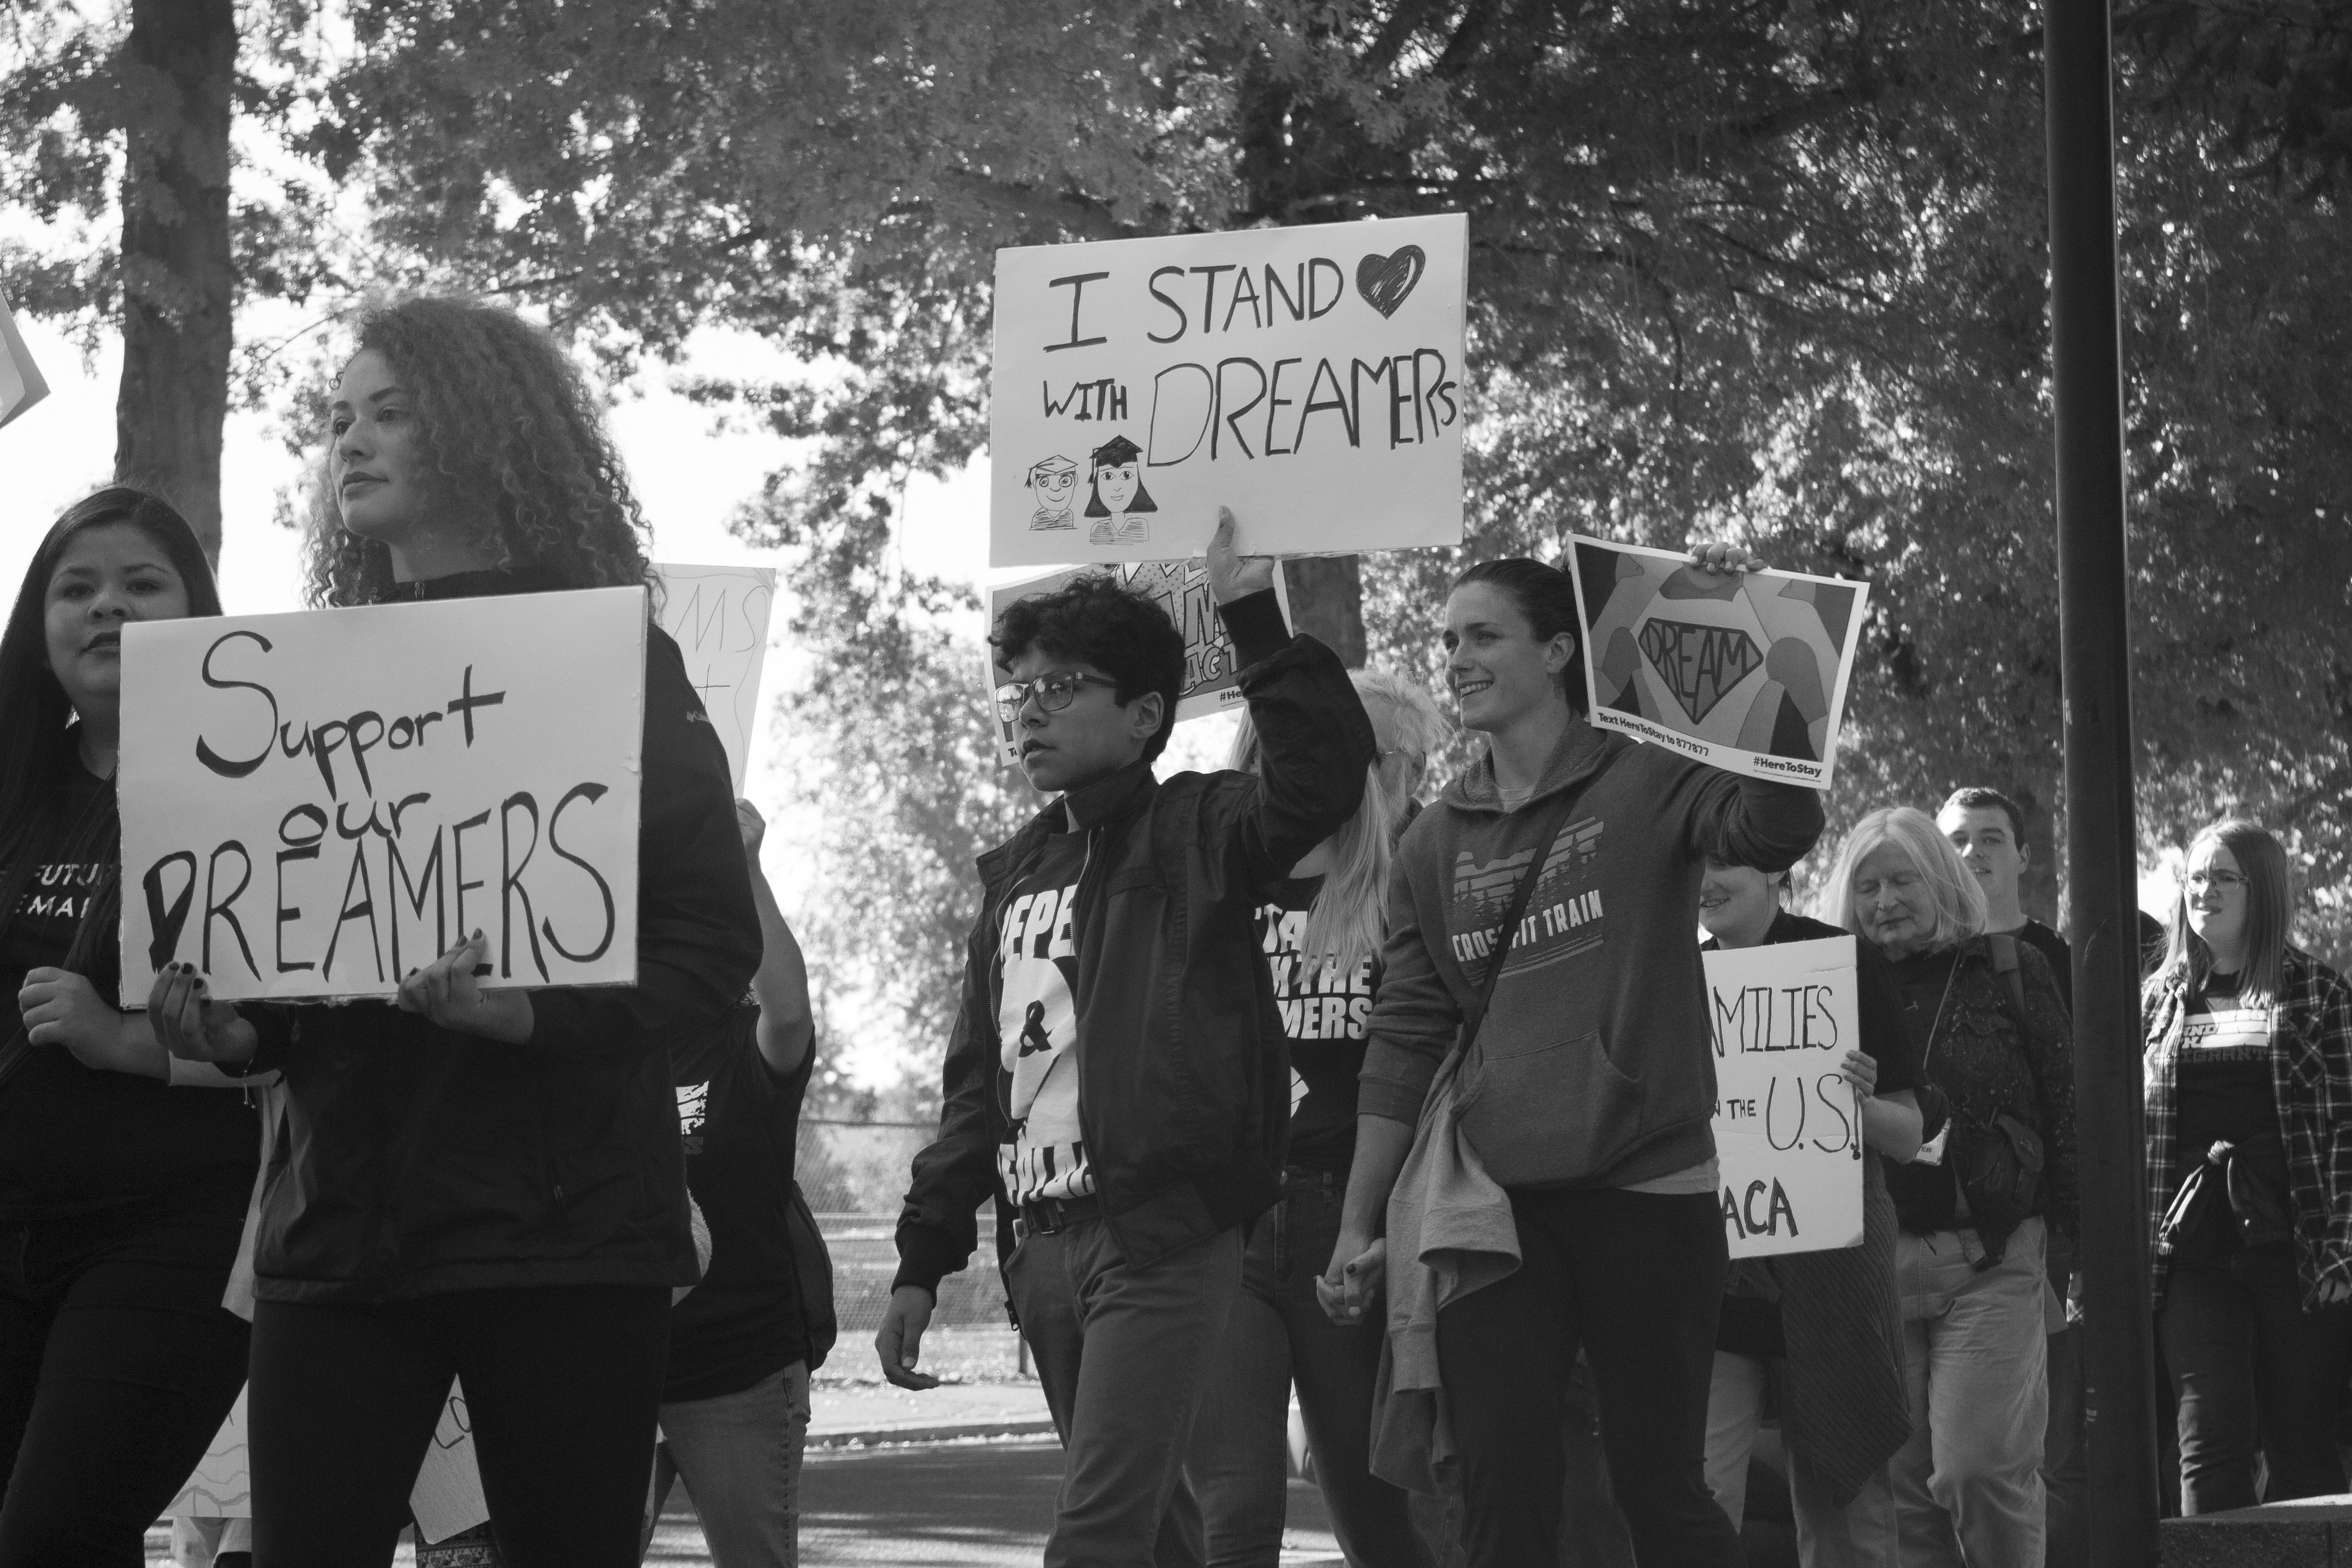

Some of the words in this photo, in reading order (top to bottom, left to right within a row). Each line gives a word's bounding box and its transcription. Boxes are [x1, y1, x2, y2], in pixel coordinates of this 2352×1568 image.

[1043, 272, 1109, 352] I
[1147, 258, 1343, 343] STAND
[1043, 378, 1127, 421] WITH
[1147, 348, 1457, 467] DREAMERS
[1646, 622, 1748, 719] DREAM
[196, 631, 506, 802] Support
[1597, 712, 1619, 725] Text
[1619, 717, 1666, 743] HereToStay
[1666, 735, 1675, 745] to
[1676, 738, 1709, 756] 877877
[1753, 756, 1822, 778] #HereToStay
[278, 791, 431, 847] our
[142, 782, 616, 983] DREAMERS
[1543, 889, 1603, 937] TRAIN
[1019, 1000, 1054, 1058] &
[1727, 1099, 1756, 1120] THE
